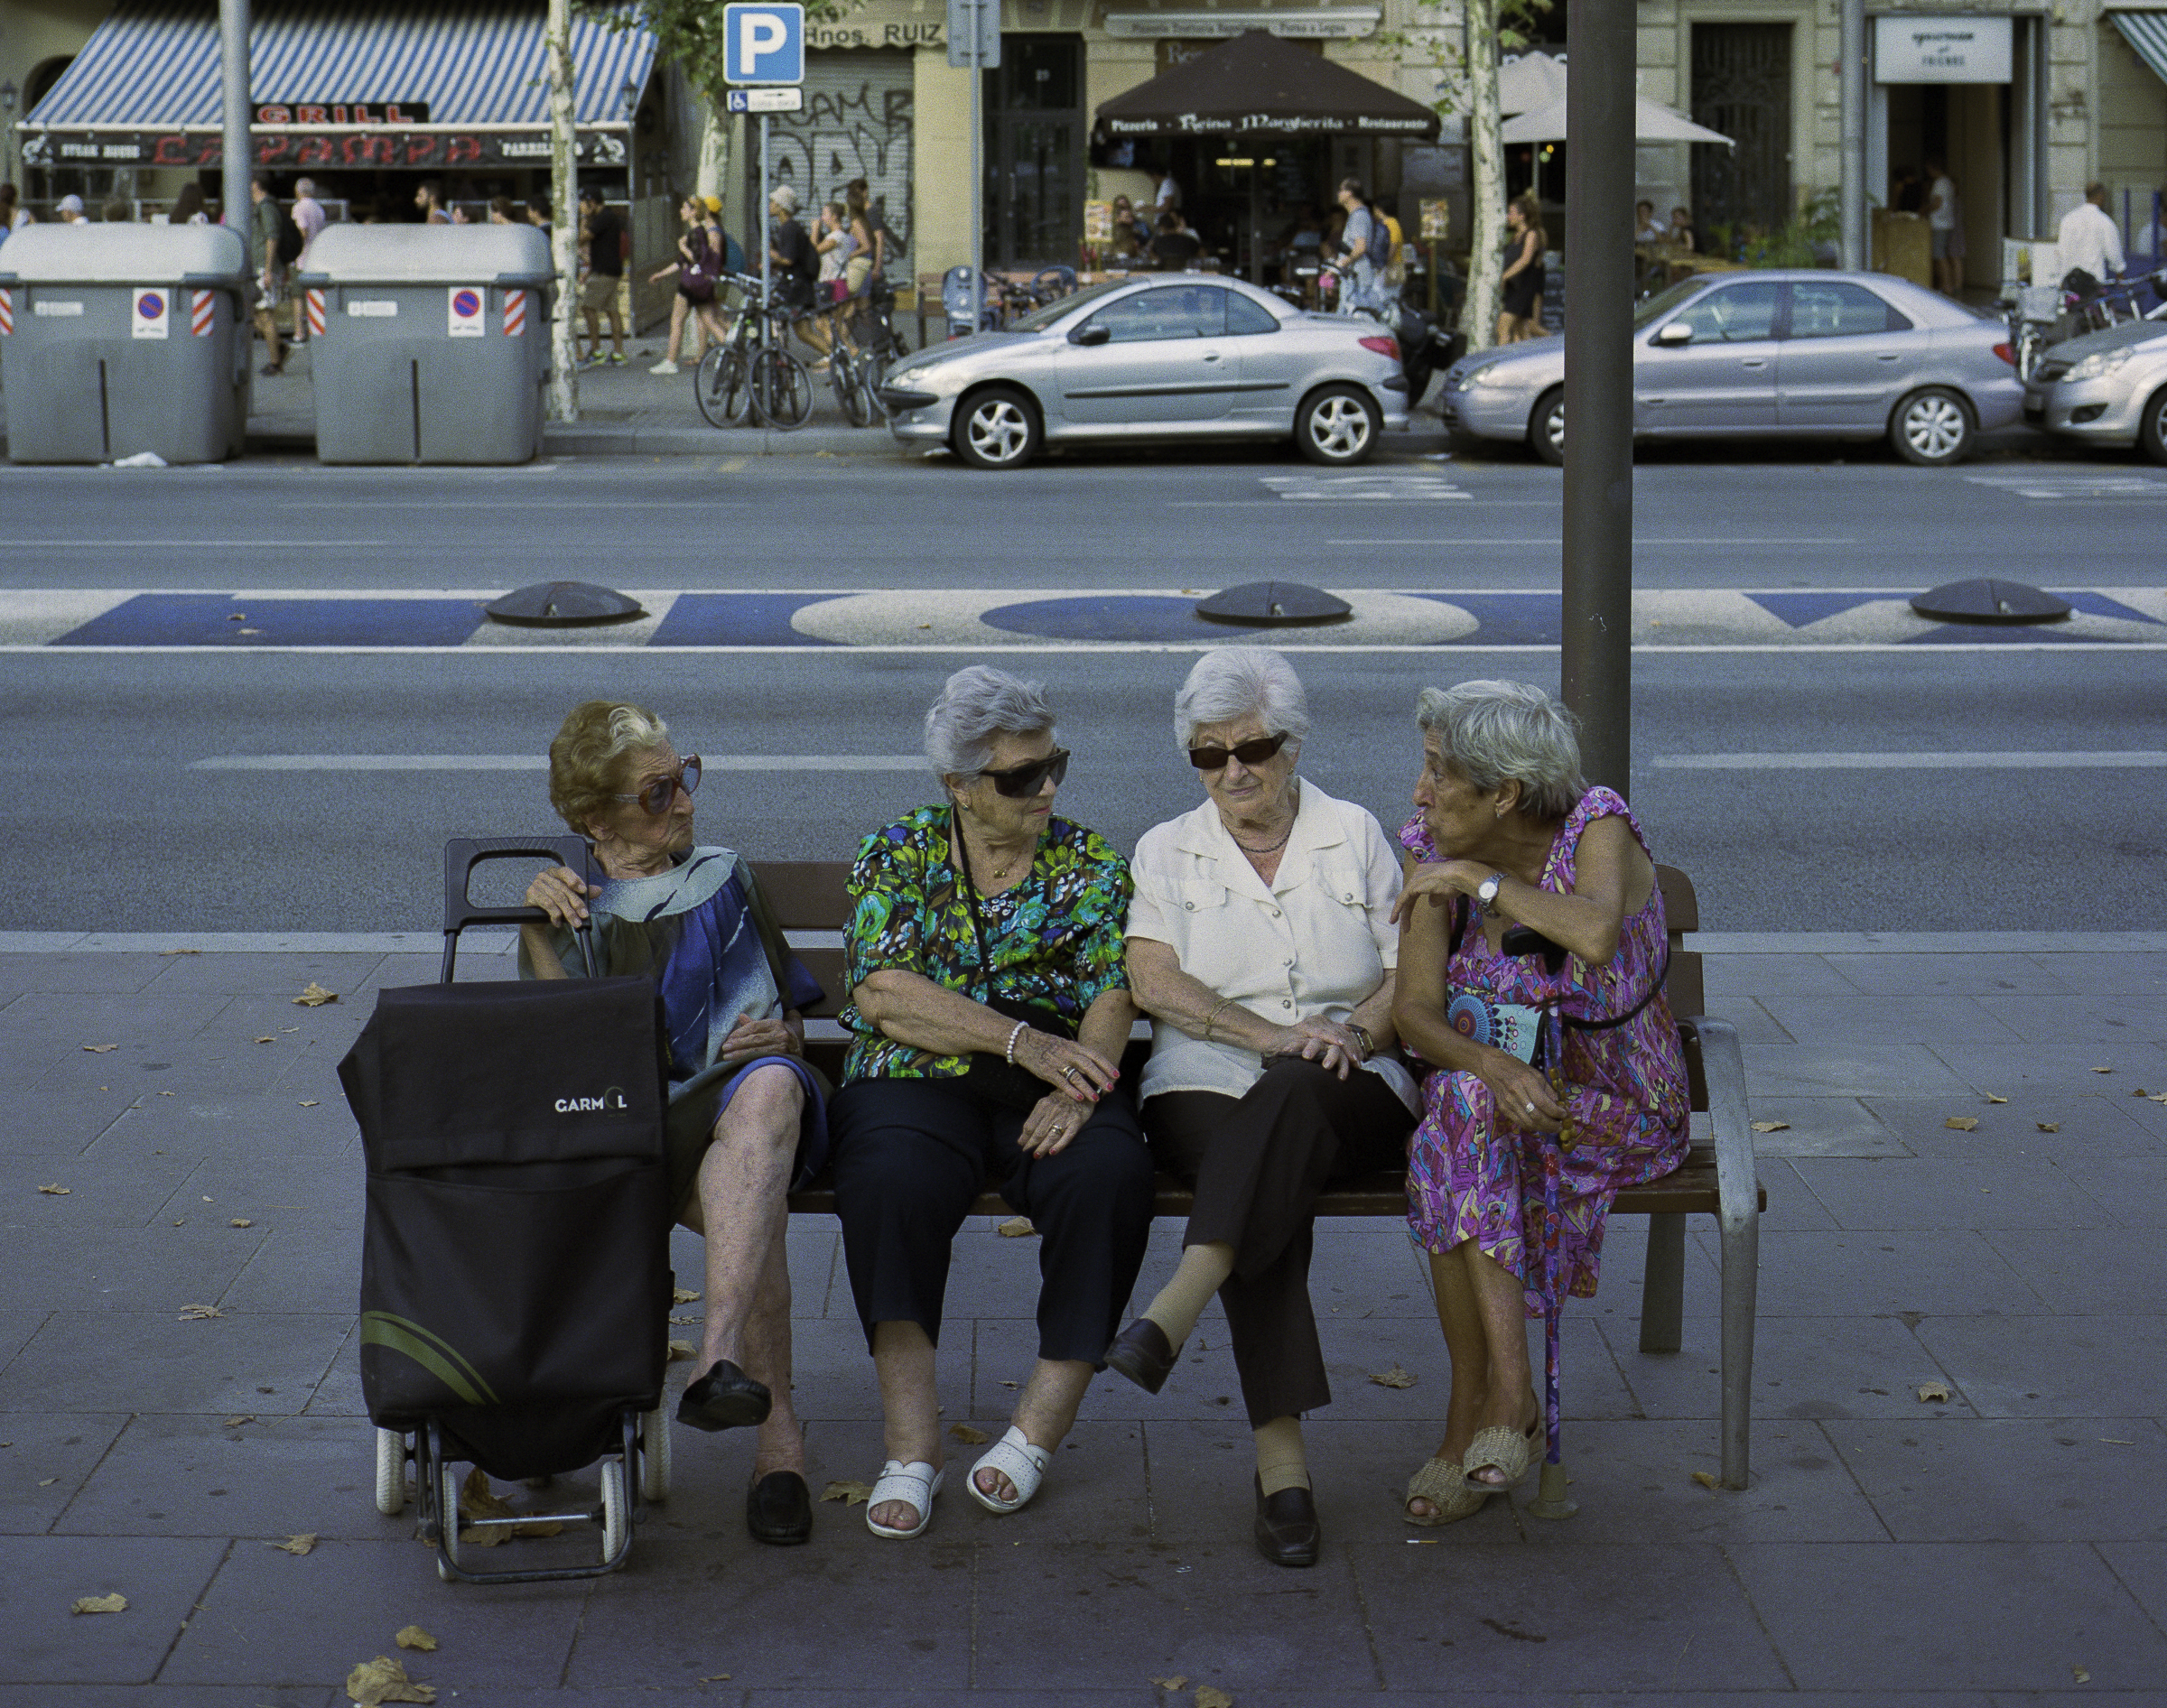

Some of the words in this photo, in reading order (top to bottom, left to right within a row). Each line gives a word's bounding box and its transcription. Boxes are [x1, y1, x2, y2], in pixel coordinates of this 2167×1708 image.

[885, 23, 943, 42] RUIZ
[739, 13, 787, 75] P
[256, 104, 415, 125] GRILL
